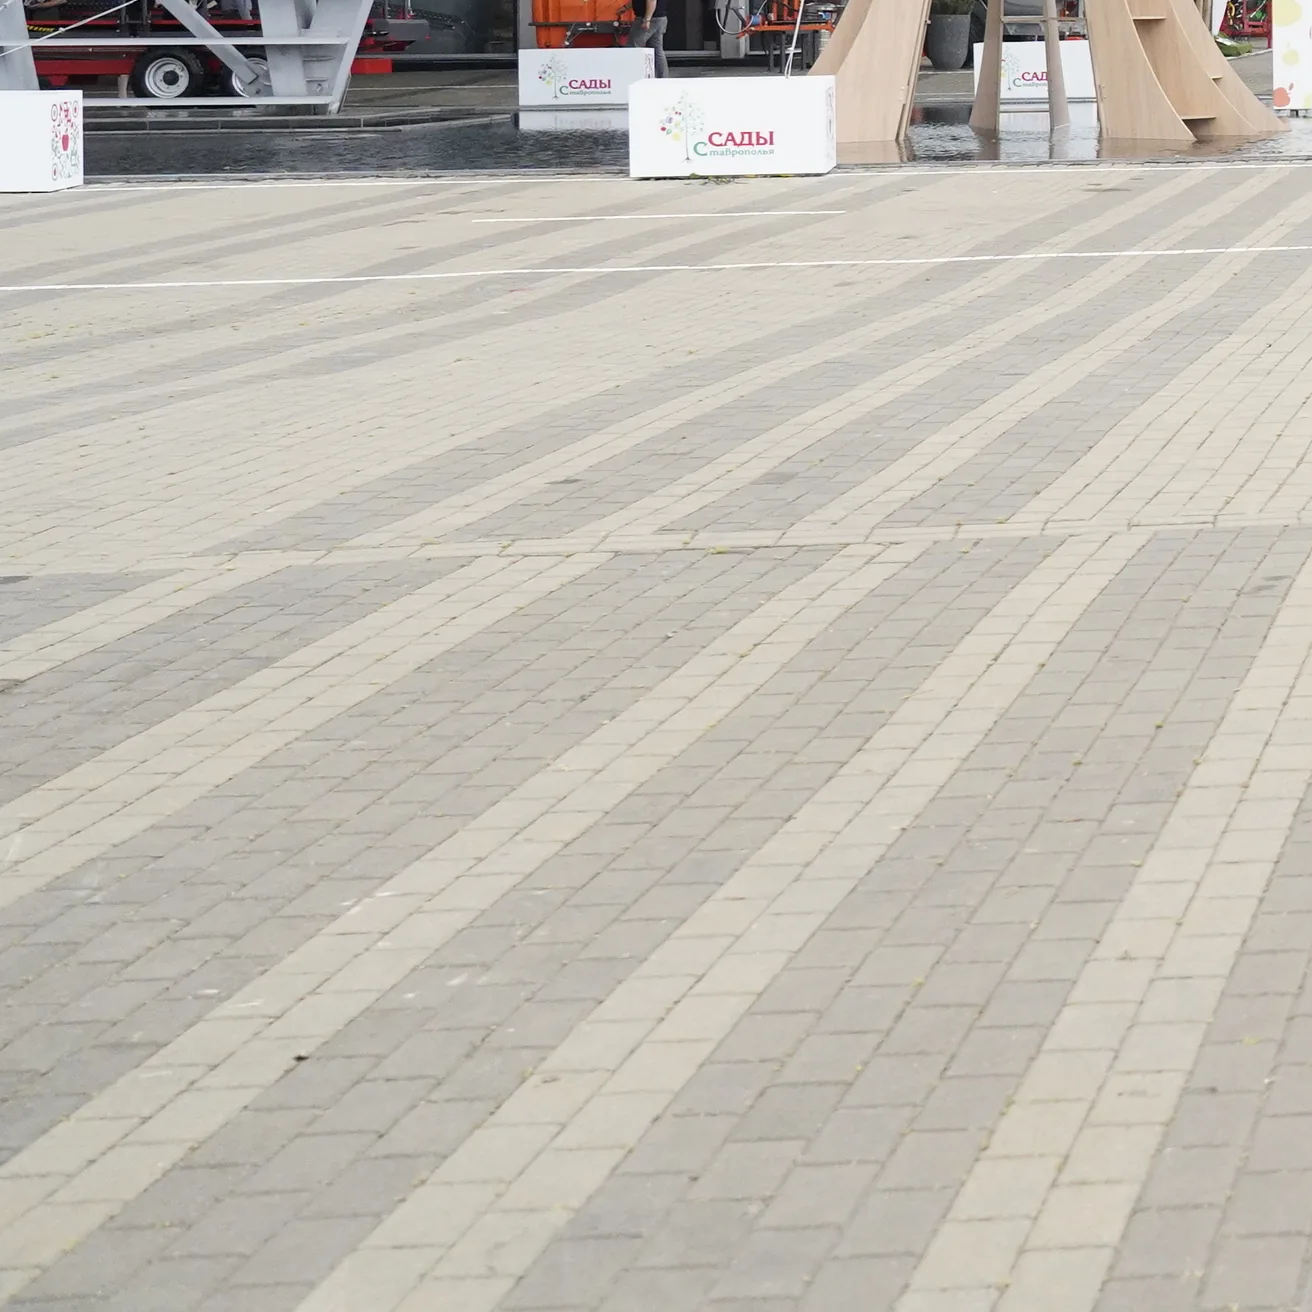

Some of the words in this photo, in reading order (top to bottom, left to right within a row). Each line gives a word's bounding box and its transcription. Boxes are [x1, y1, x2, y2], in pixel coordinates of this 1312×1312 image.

[1021, 71, 1048, 81] САД
[568, 79, 611, 90] САДЫ
[707, 130, 775, 147] САДЫ
[693, 141, 775, 157] Ставрополья
